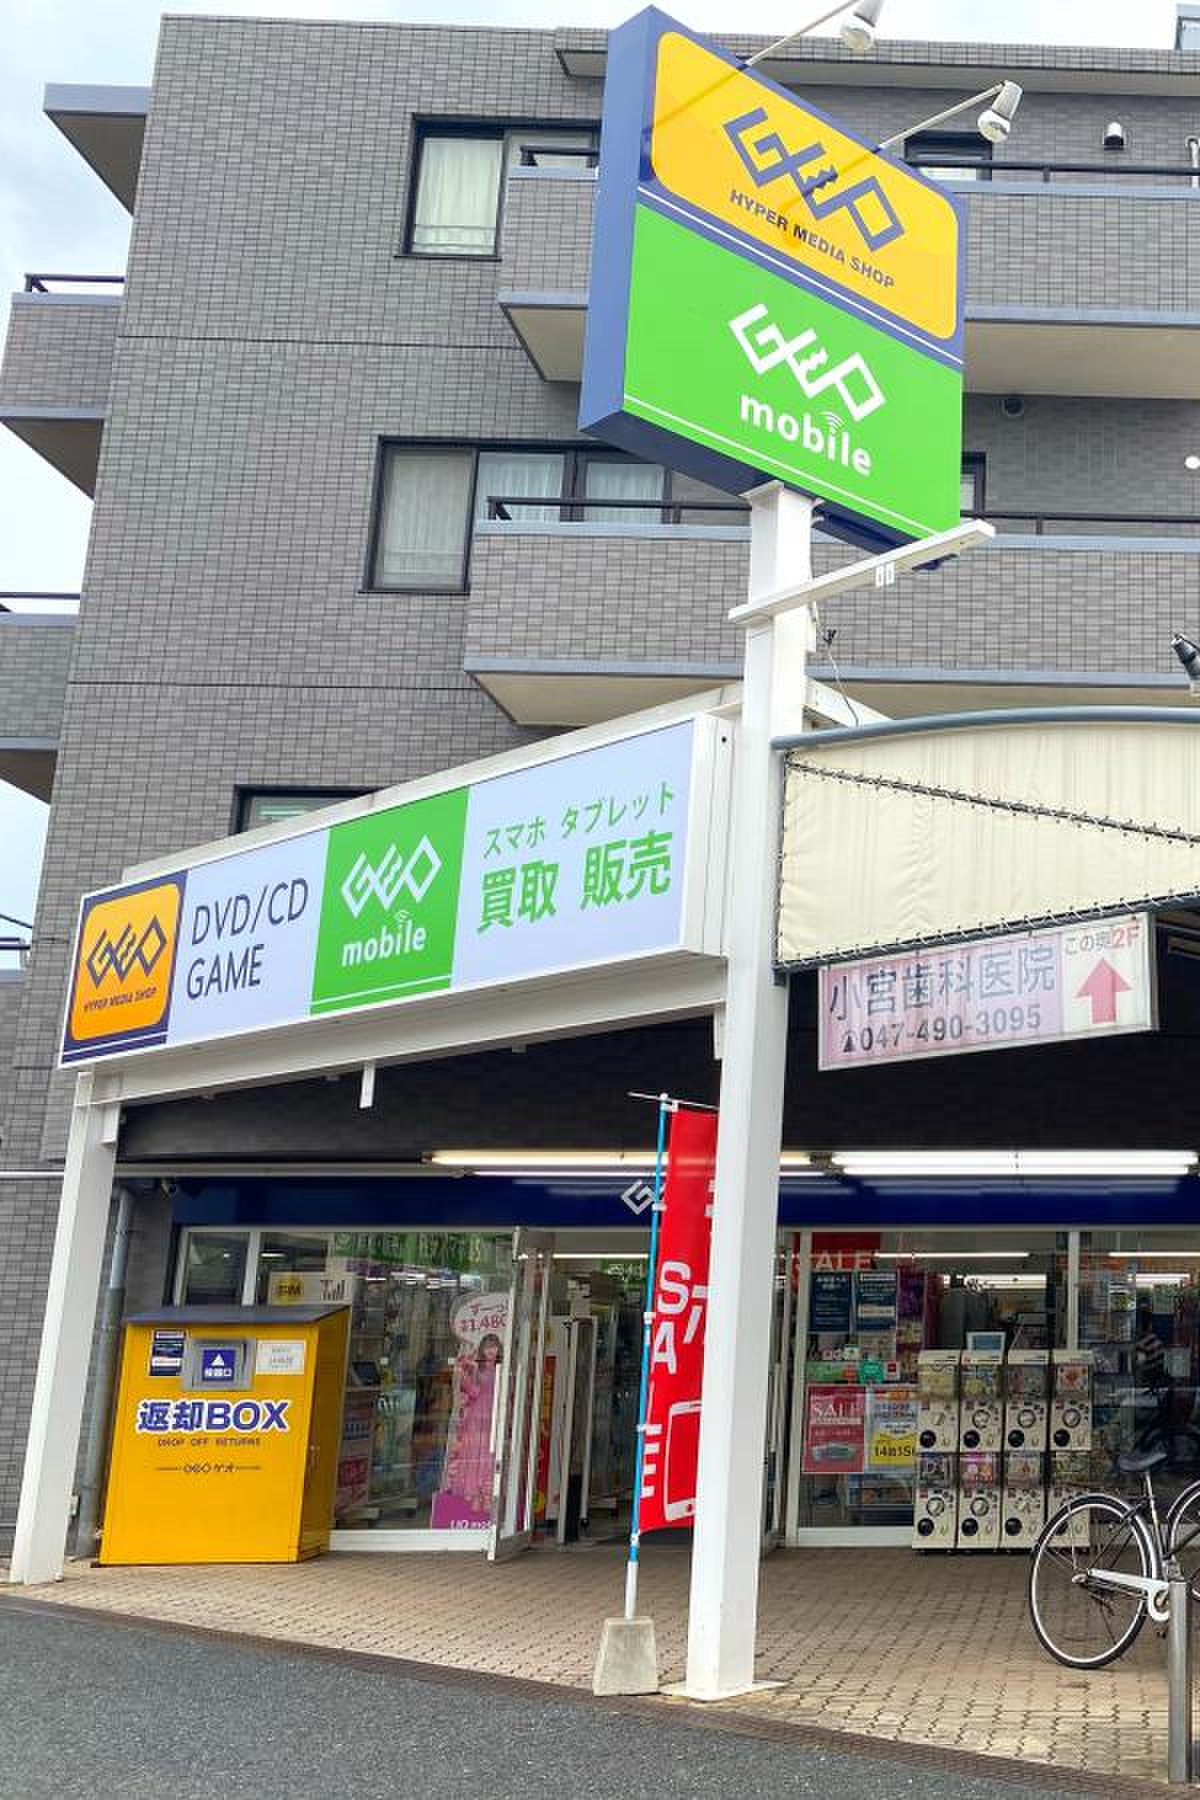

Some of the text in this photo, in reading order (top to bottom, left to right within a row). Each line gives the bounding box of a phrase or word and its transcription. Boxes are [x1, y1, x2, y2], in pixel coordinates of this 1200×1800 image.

[730, 189, 896, 288] HYPER MEDIA SHOP
[740, 393, 873, 477] mobile
[484, 781, 674, 859] スマホ タブレット
[192, 878, 308, 945] DVD/CD
[477, 830, 673, 934] 買取 販売
[187, 944, 264, 1000] GAME
[342, 920, 427, 968] mobile
[829, 944, 1056, 1022] 小宮歯科医院
[138, 1401, 290, 1432] 返却BOX
